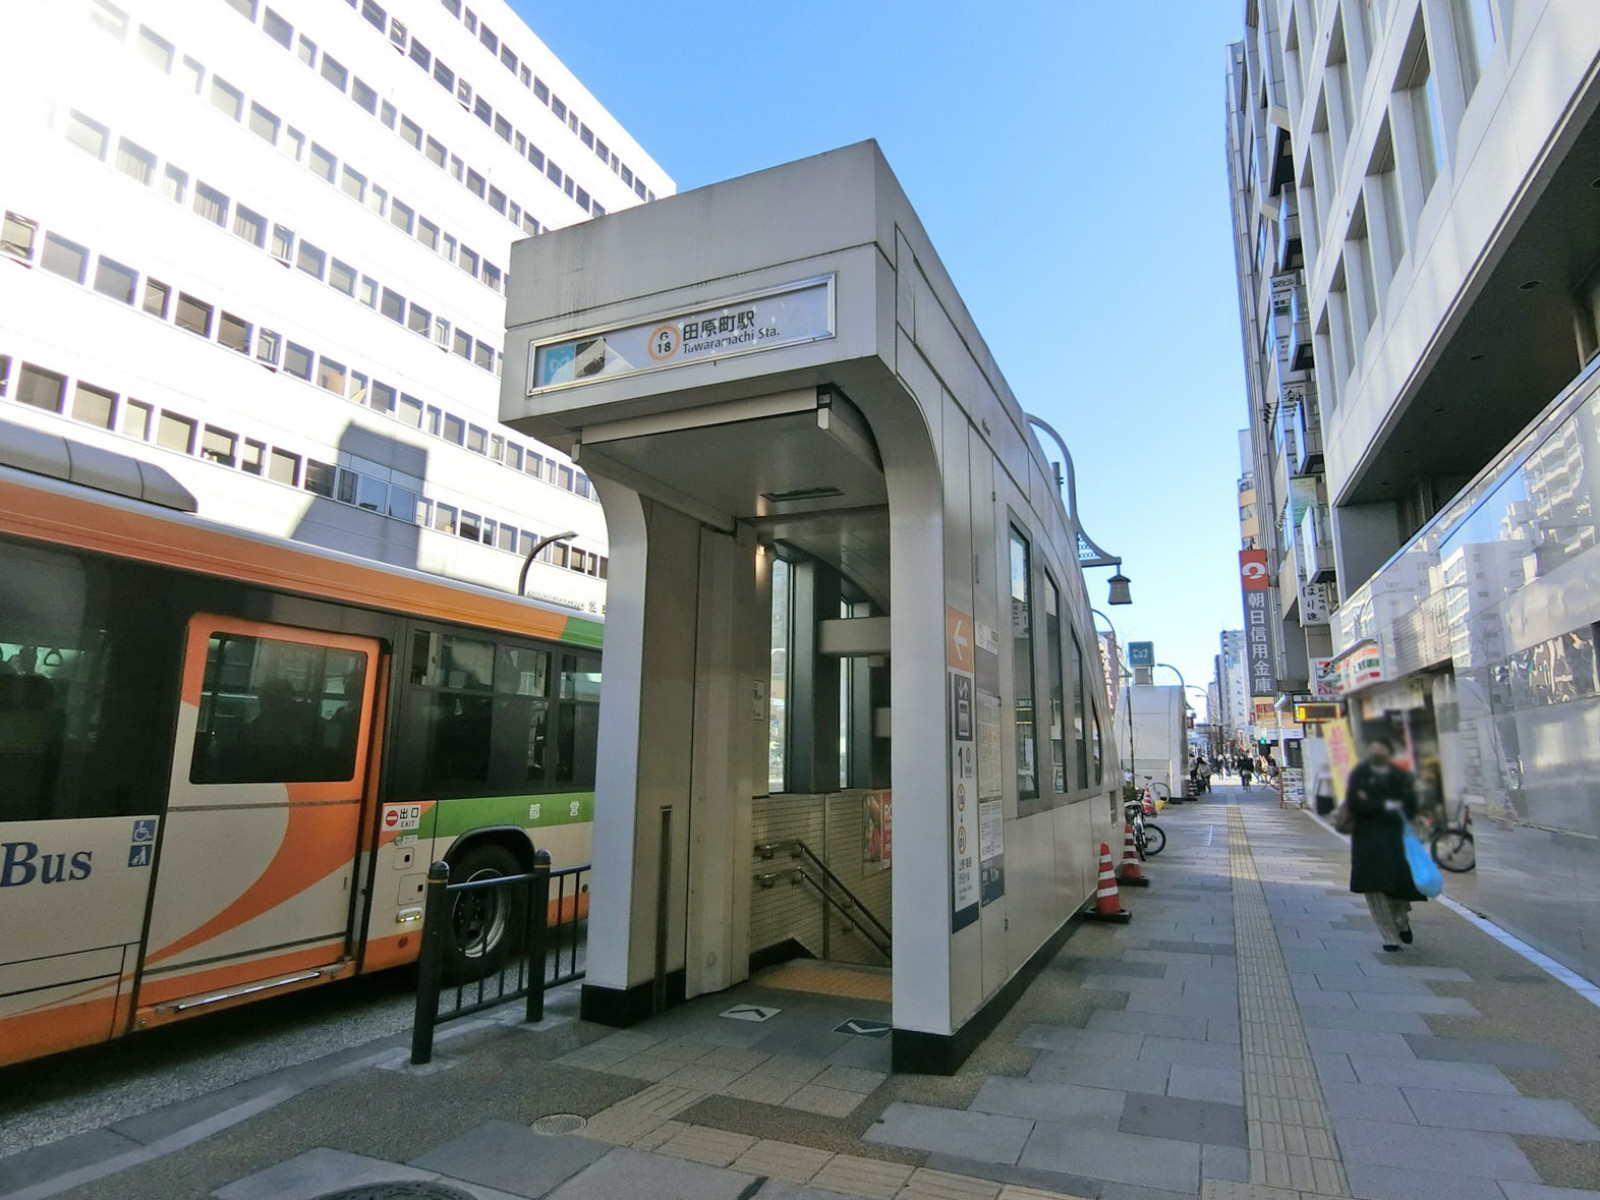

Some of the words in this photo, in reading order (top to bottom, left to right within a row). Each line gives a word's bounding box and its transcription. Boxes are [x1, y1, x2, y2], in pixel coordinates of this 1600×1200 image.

[660, 331, 669, 341] G
[683, 310, 755, 342] 田原町駅
[657, 341, 671, 354] 18
[683, 330, 755, 354] Tawaramachi
[758, 327, 780, 340] Sta.
[1248, 592, 1272, 693] 朝日信用金庫
[399, 807, 419, 819] 出口
[400, 820, 415, 828] EXIT
[0, 841, 93, 888] Bus
